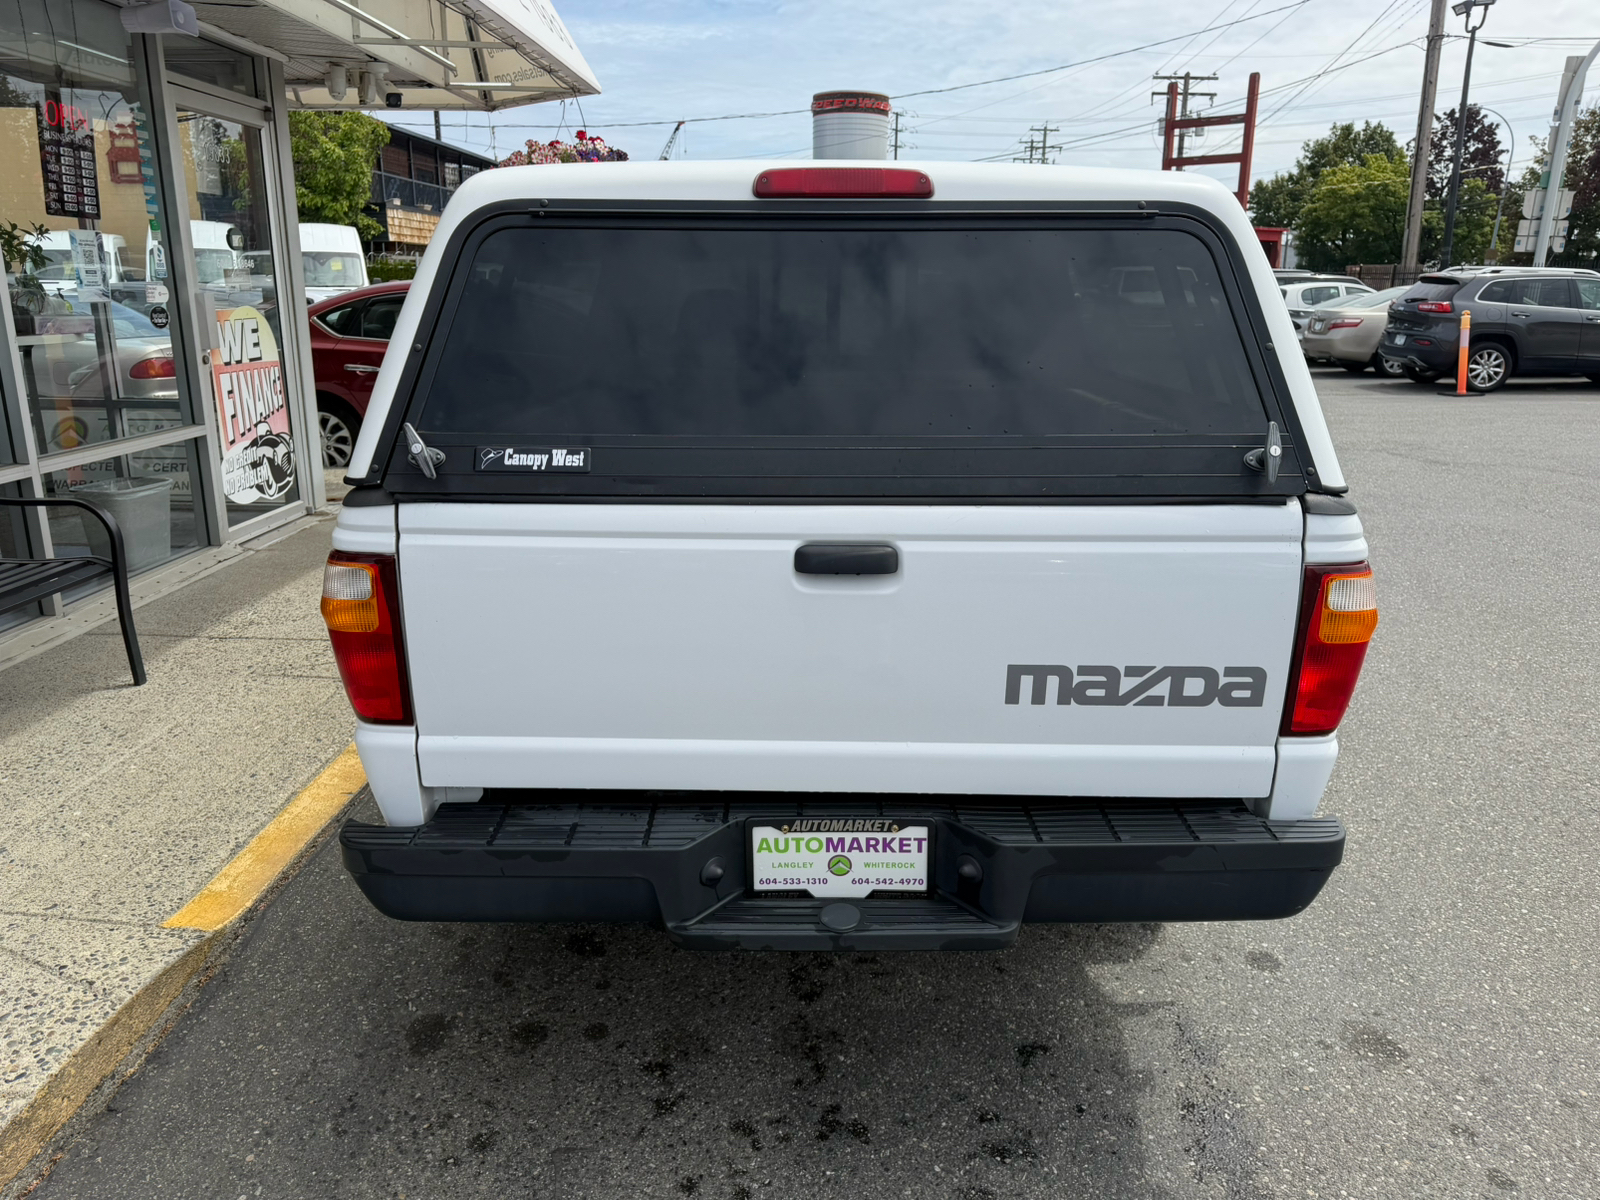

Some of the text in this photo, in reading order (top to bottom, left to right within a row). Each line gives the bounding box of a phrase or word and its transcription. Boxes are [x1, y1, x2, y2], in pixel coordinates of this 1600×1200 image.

[45, 100, 89, 132] OPEN
[43, 129, 92, 147] BUSINESS HOURS
[45, 145, 58, 153] MON
[46, 154, 56, 162] TUE
[217, 317, 262, 365] WE
[219, 366, 284, 445] FINANCE
[224, 456, 234, 475] NO
[504, 448, 584, 470] Canopy West
[224, 463, 269, 496] NO PROBLEM
[790, 820, 893, 832] AUTOMARKET
[756, 836, 927, 854] AUTOMARKET
[851, 878, 924, 886] 604-542-4970
